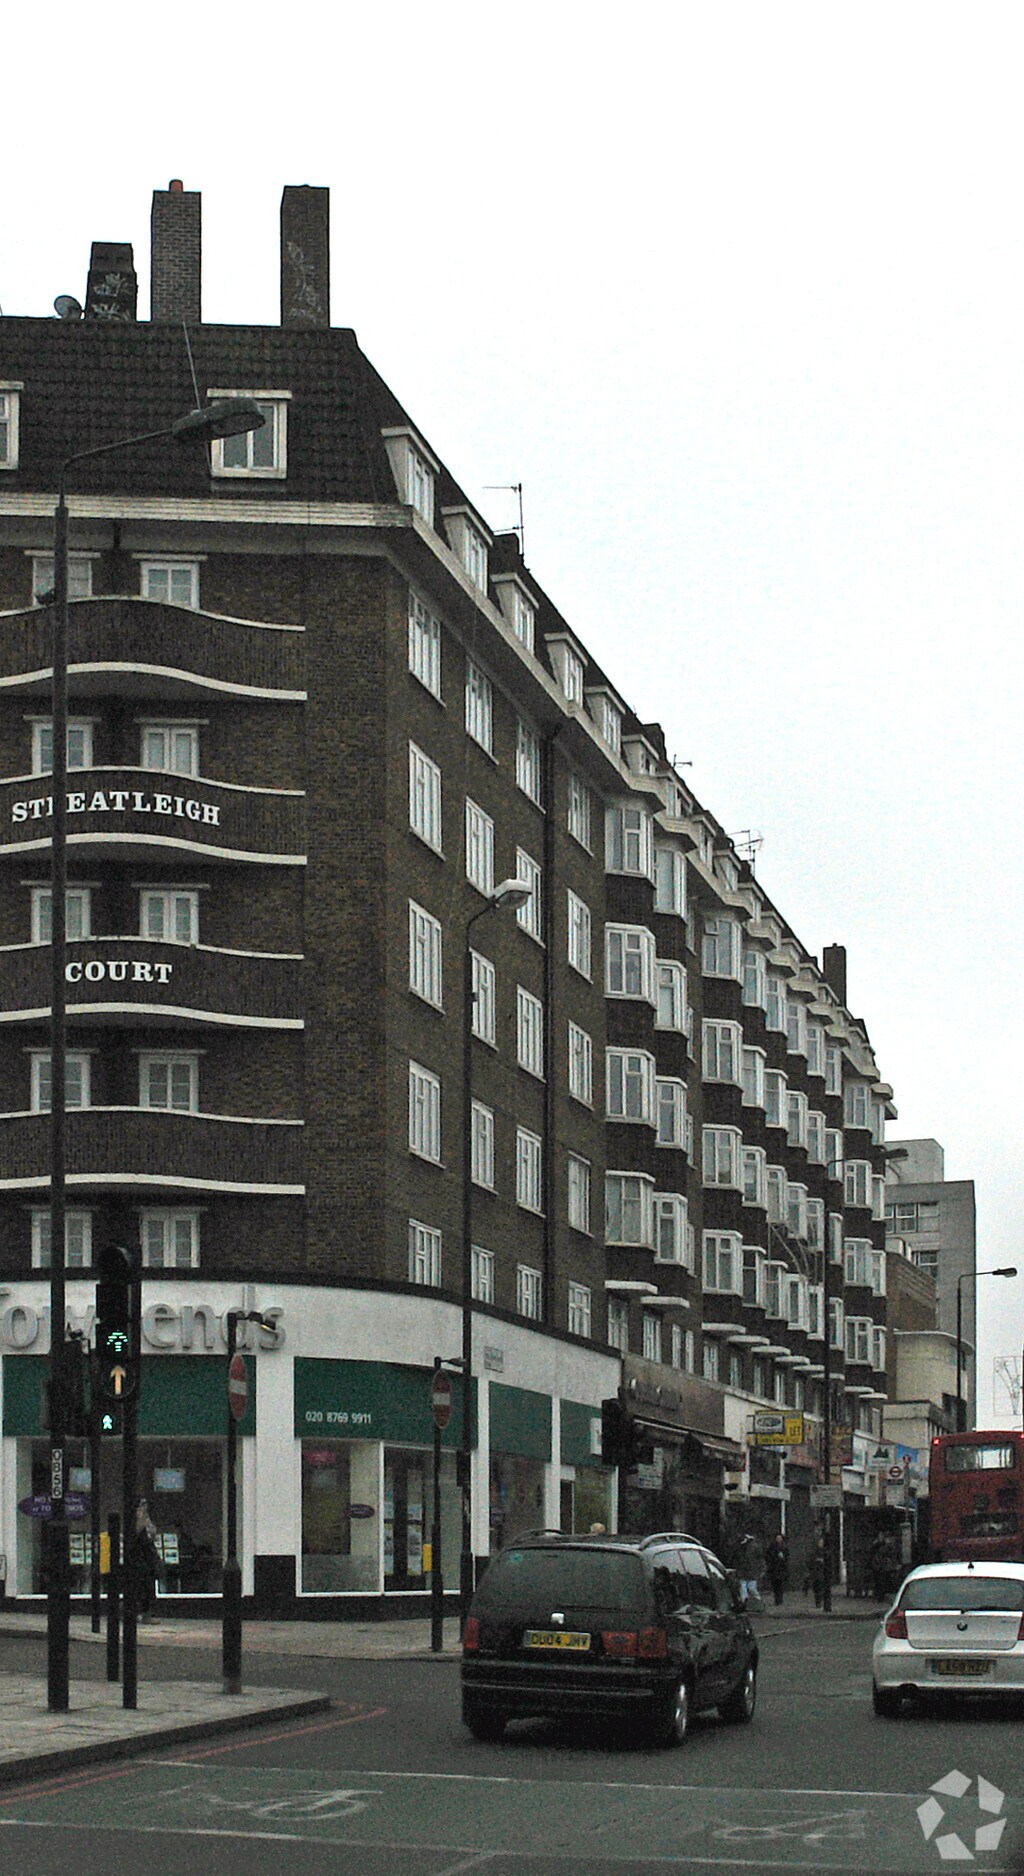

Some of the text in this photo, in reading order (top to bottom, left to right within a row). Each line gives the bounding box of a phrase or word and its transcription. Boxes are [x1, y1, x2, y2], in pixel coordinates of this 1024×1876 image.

[12, 791, 221, 826] STEATLEIGH
[64, 961, 173, 983] COURT
[305, 1411, 372, 1424] 020 8769 9911
[52, 1450, 62, 1496] 0856
